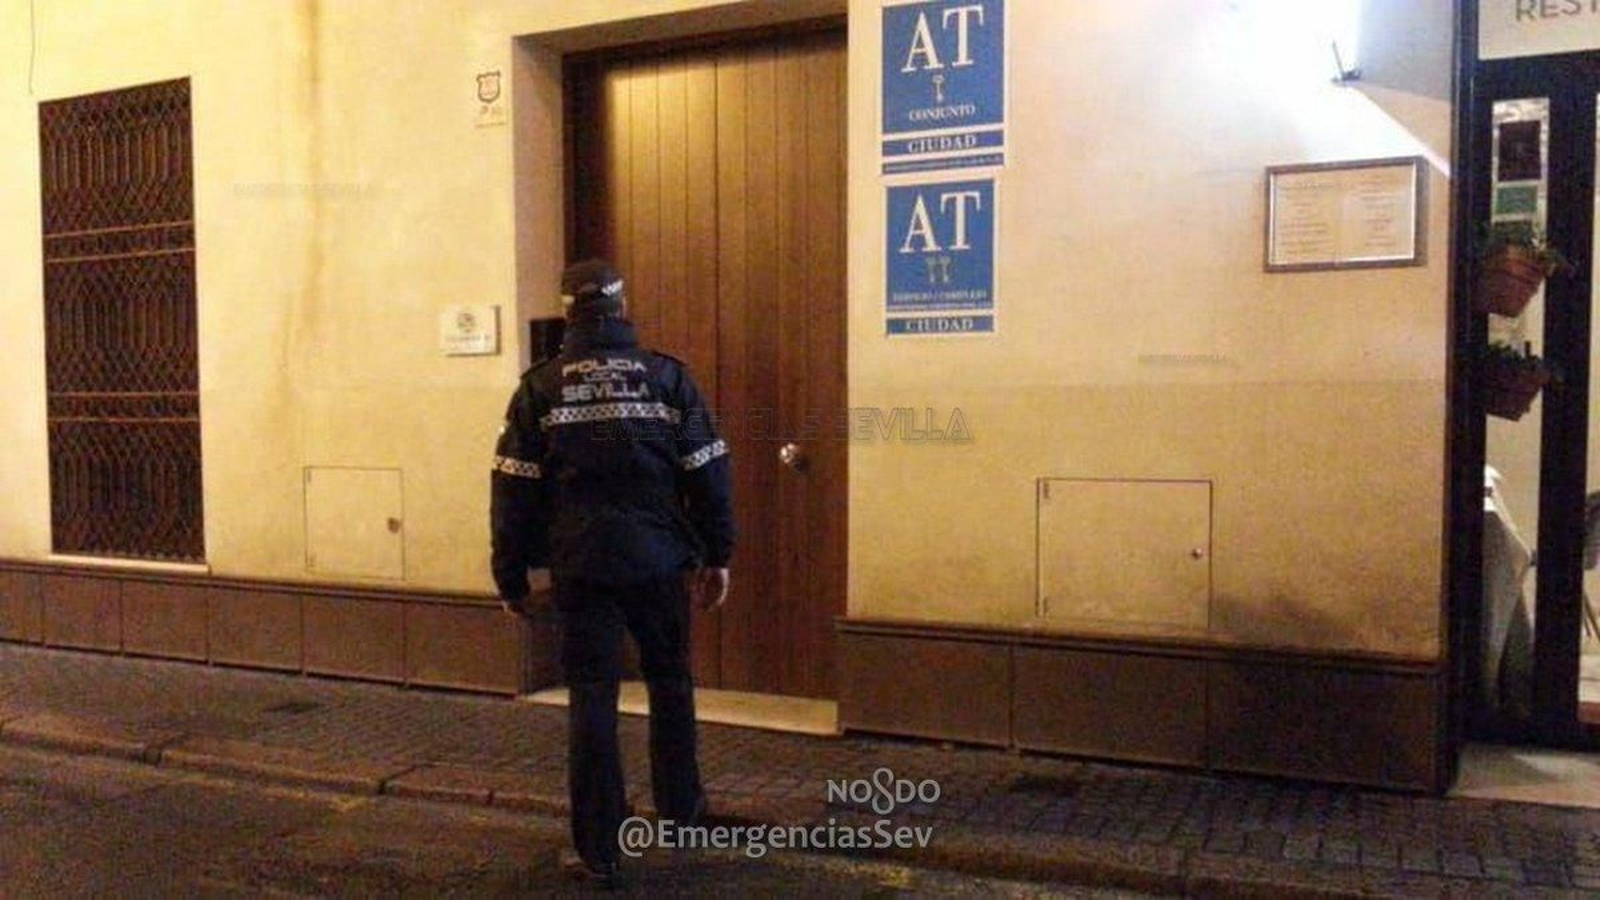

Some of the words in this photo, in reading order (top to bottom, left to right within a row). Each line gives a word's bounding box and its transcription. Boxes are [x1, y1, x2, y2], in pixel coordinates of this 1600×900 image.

[900, 4, 984, 73] AT
[908, 103, 976, 122] CONJUNTO
[908, 134, 977, 154] CIUDAD
[899, 190, 981, 253] AT
[905, 317, 974, 331] CIUDAD
[562, 382, 650, 402] SEVILLA
